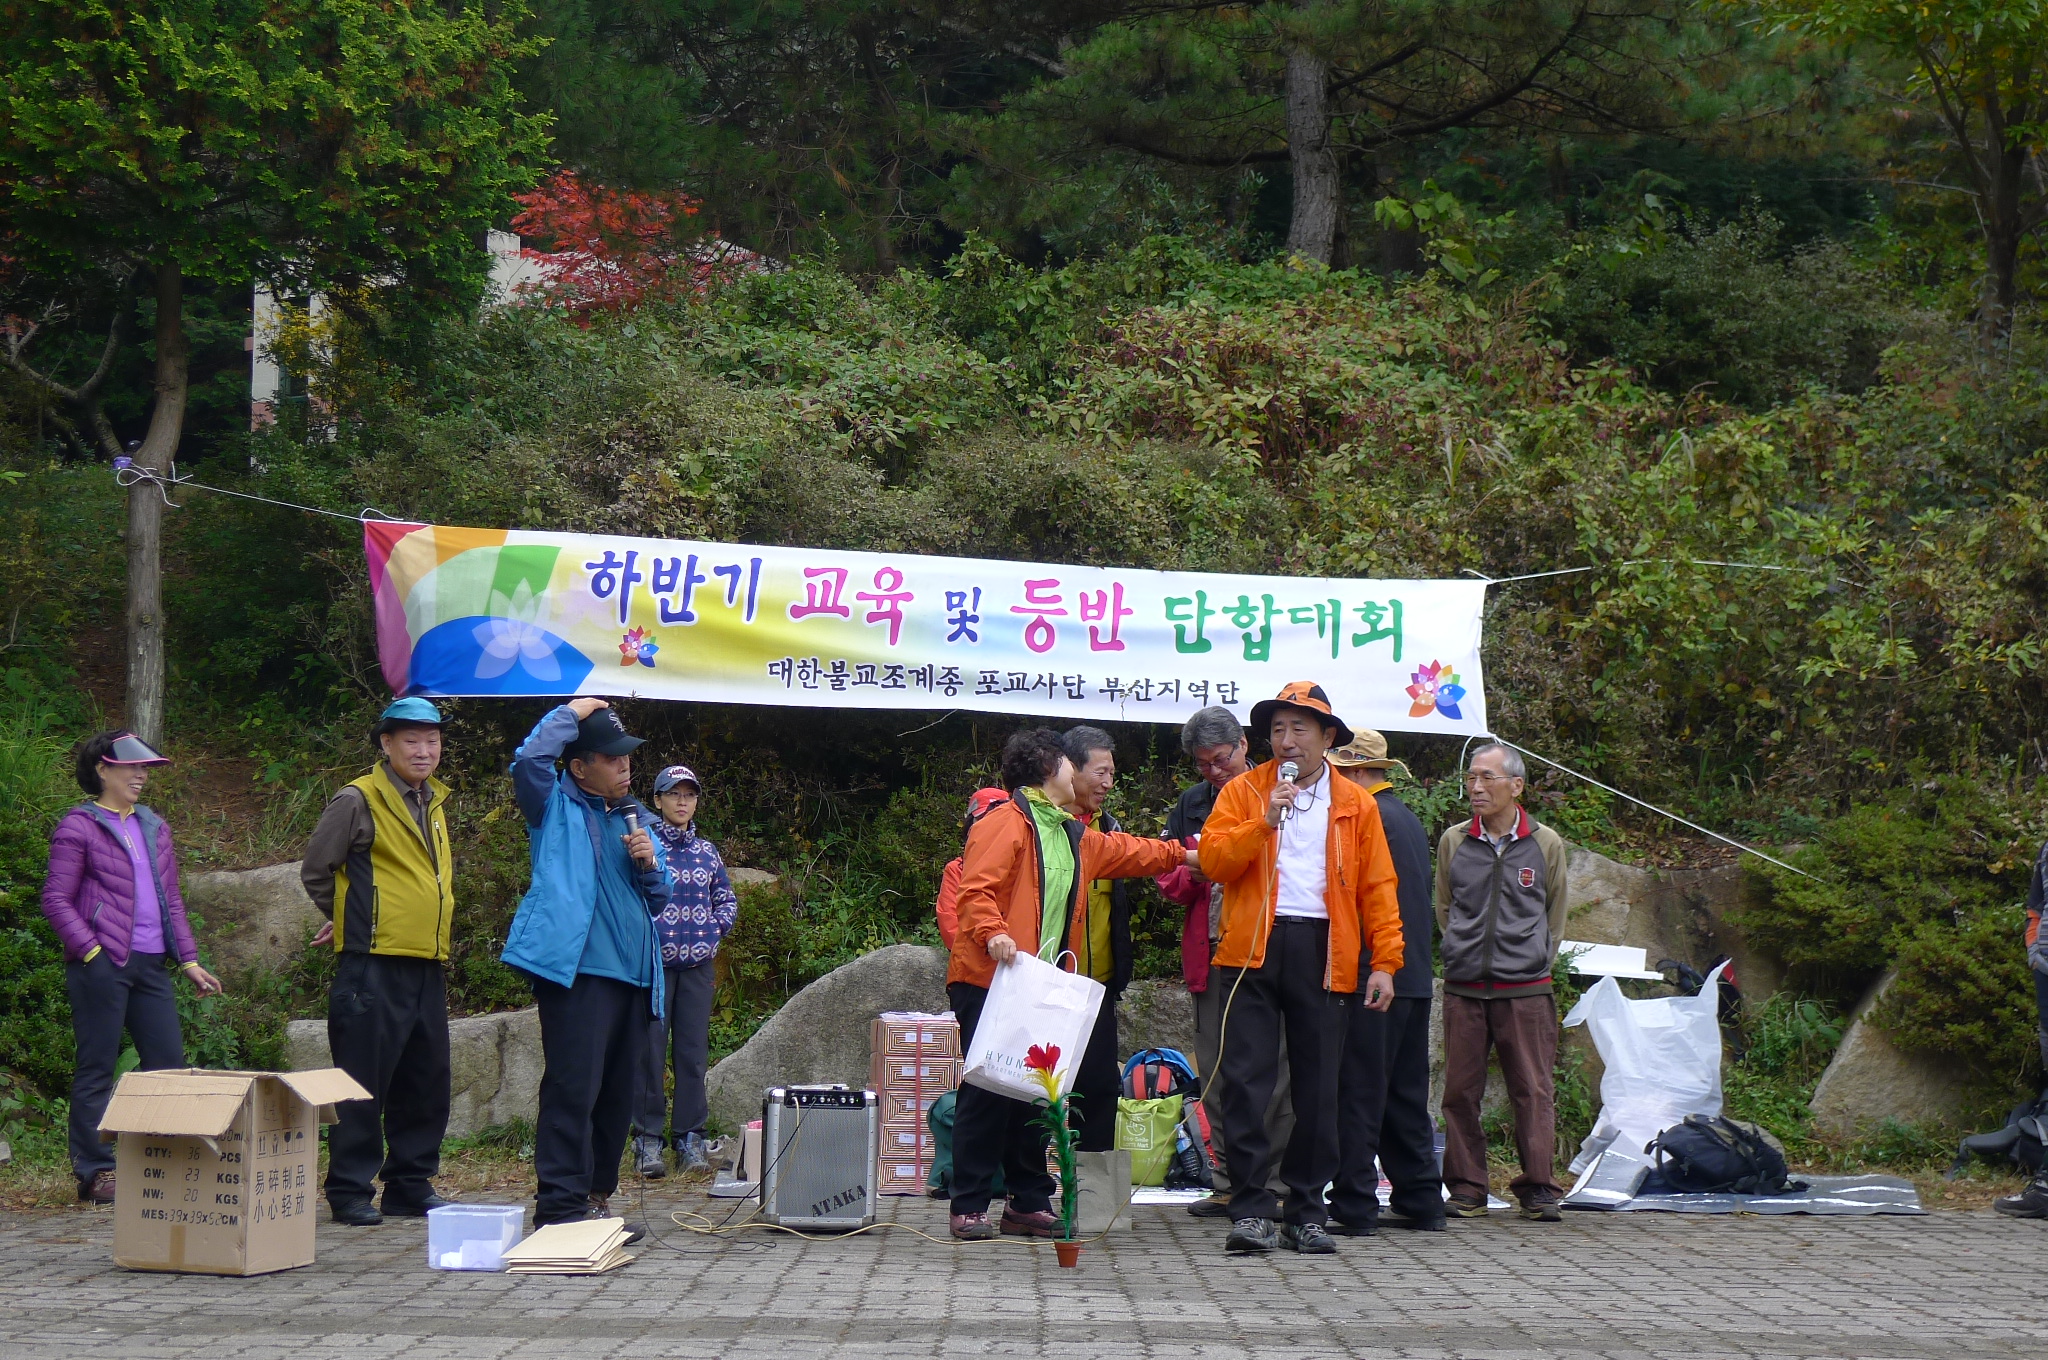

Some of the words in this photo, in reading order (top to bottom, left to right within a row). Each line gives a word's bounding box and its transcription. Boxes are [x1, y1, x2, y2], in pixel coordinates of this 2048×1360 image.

[586, 550, 763, 624] 하반기
[791, 566, 914, 645] 교육
[945, 586, 982, 643] 및
[1011, 579, 1133, 653] 등반
[1164, 589, 1403, 663] 단합대회
[768, 657, 964, 700] 대한불교조계종
[974, 670, 1086, 700] 포교사단
[1099, 677, 1240, 706] 부산지역단
[145, 1147, 171, 1159] QTY:
[220, 1152, 241, 1163] PCS
[144, 1168, 165, 1179] GW:
[185, 1168, 199, 1181] 23
[217, 1173, 239, 1184] KGS
[255, 1164, 306, 1196] 易碎制品
[143, 1188, 163, 1200] NW:
[184, 1188, 198, 1202] 20
[216, 1194, 238, 1204] KGS
[254, 1192, 306, 1224] 小心轻放
[811, 1185, 867, 1217] ATAKA
